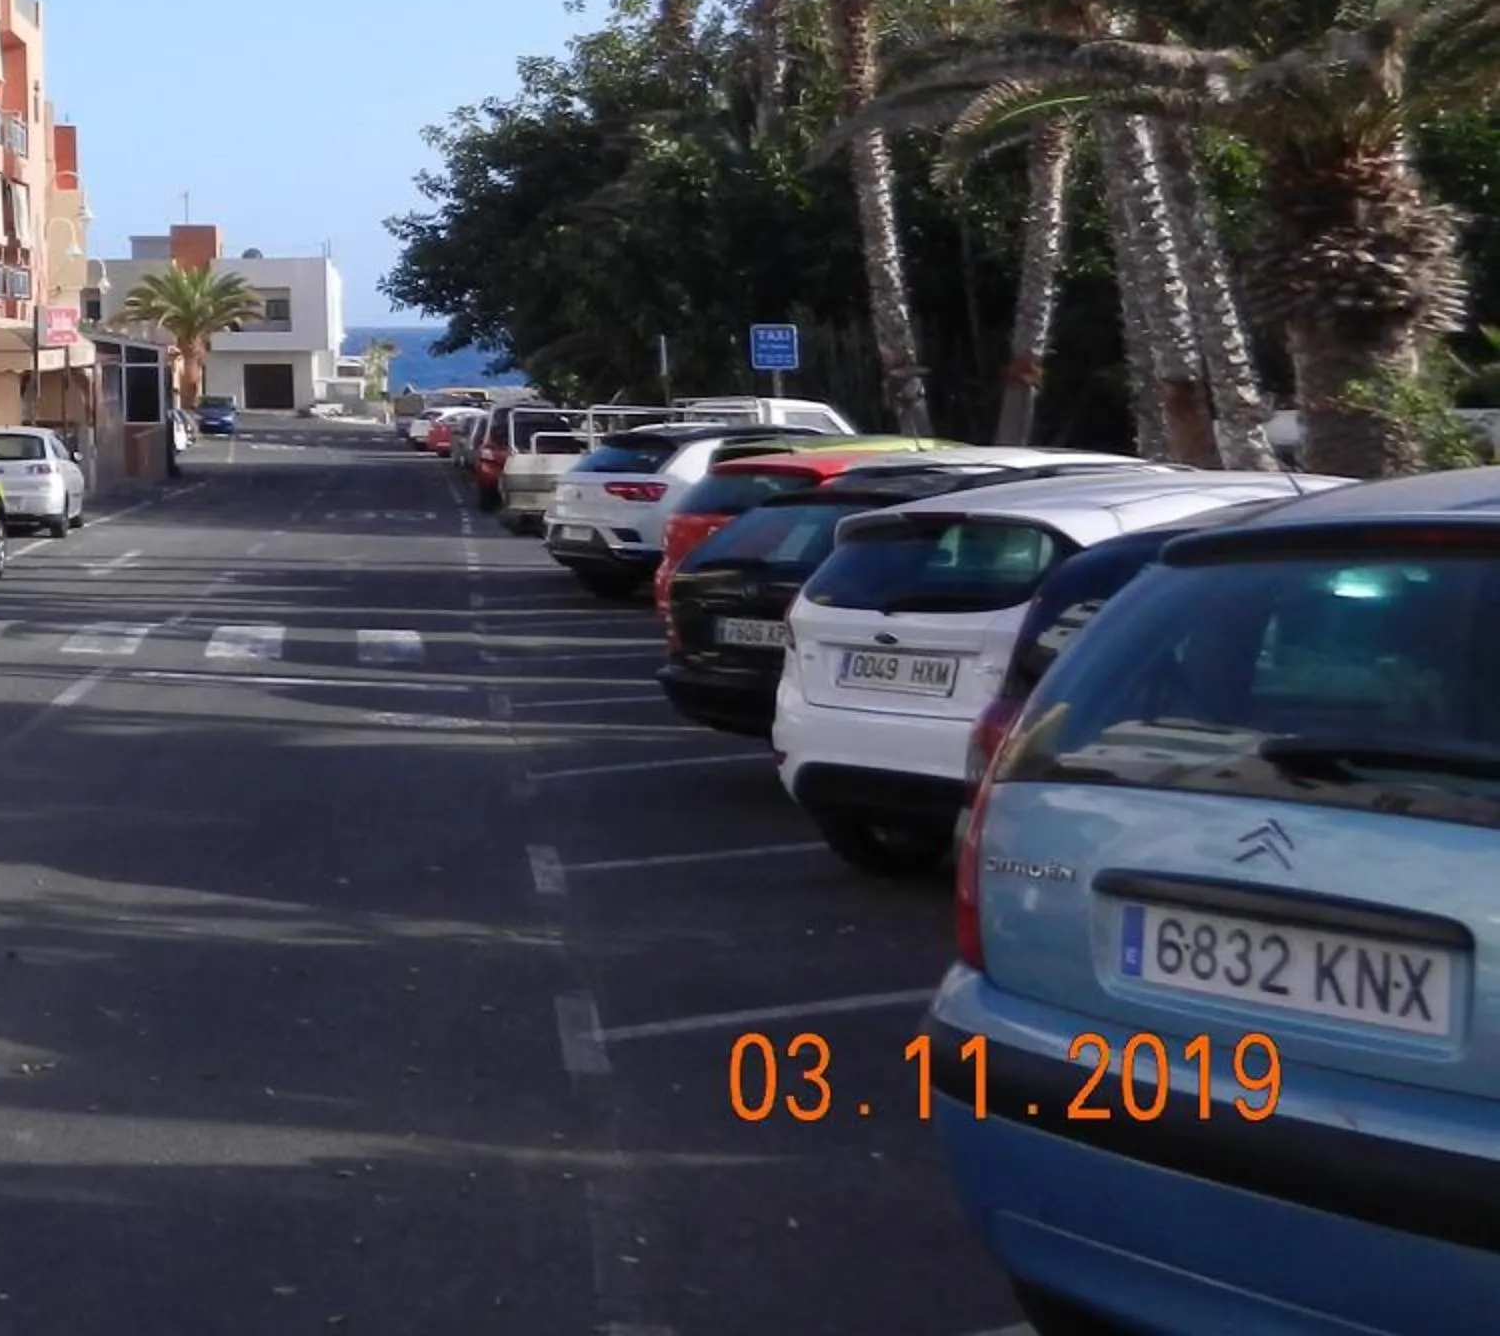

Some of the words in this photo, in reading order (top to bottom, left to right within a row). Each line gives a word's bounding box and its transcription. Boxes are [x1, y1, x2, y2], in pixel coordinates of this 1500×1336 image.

[852, 655, 898, 680] 0049
[911, 660, 949, 686] HXM
[1156, 918, 1291, 996] 6832
[1314, 941, 1432, 1022] KNX
